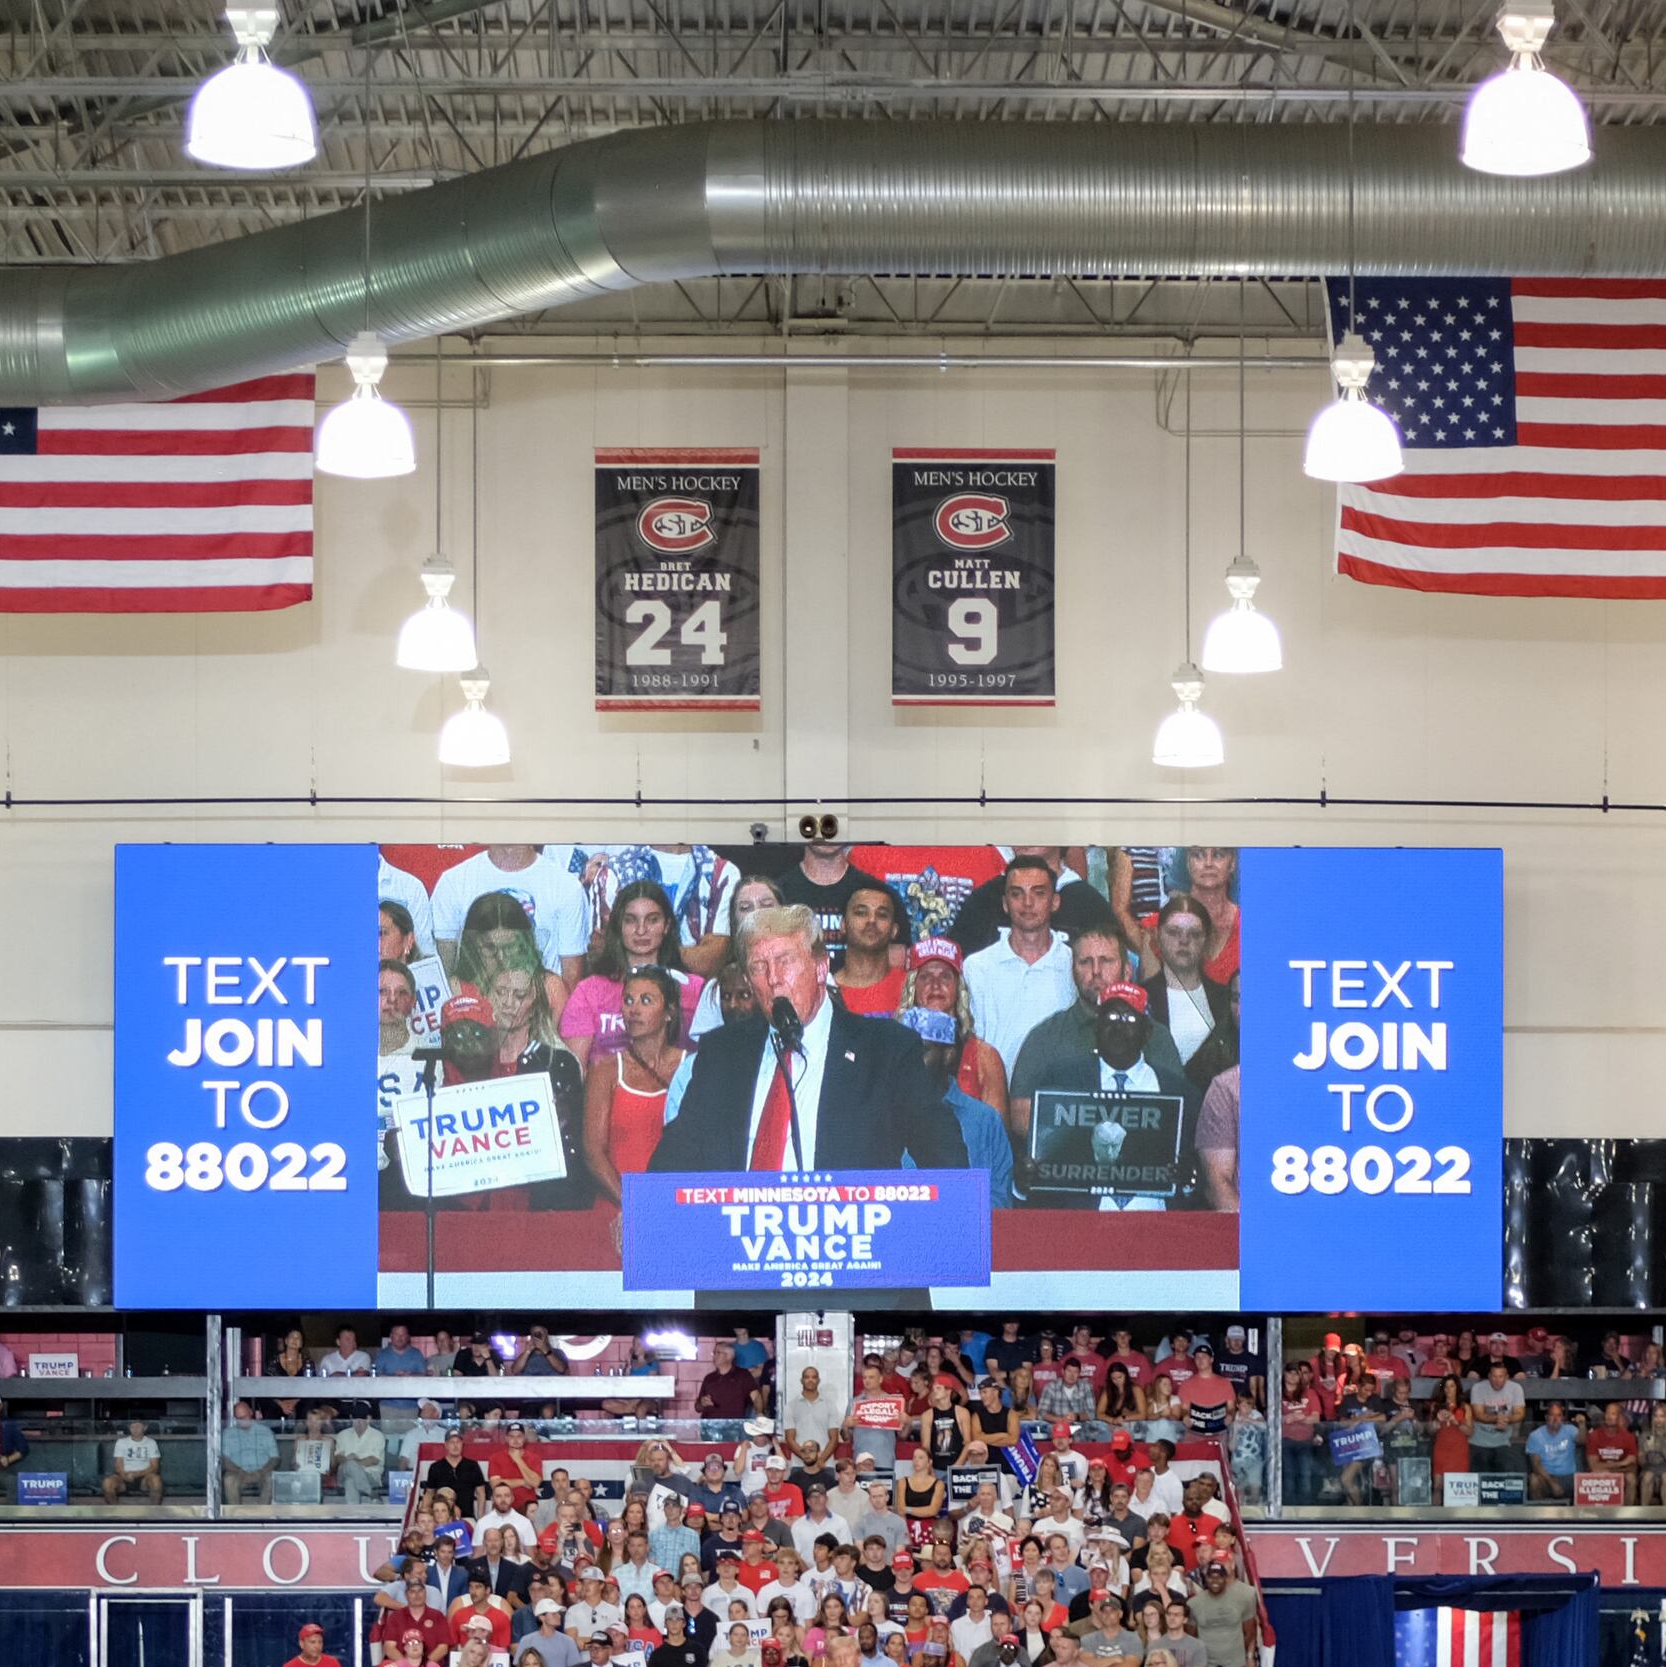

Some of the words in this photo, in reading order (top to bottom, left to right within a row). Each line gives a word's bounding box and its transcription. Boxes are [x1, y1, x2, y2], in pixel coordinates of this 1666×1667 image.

[616, 475, 668, 491] MEN'S
[672, 475, 742, 492] HOCKEY
[913, 471, 965, 486] MEN'S
[968, 471, 1039, 487] HOCKEY
[659, 562, 692, 572] BRET
[954, 559, 991, 569] MATT
[624, 573, 732, 591] HEDICAN
[928, 570, 1021, 589] CULLEN
[625, 599, 728, 666] 24
[947, 597, 998, 666] 9
[632, 674, 720, 688] 1988-1991
[928, 674, 1017, 688] 1995-1997
[163, 956, 330, 1006] TEXT
[1289, 960, 1454, 1009] TEXT
[167, 1018, 323, 1069] JOIN
[1292, 1022, 1448, 1072] JOIN
[202, 1080, 290, 1130] TO
[1327, 1083, 1415, 1134] TO
[409, 1099, 541, 1140] TRUMP
[1053, 1102, 1163, 1129] NEVER
[430, 1126, 532, 1160] VANCE
[145, 1142, 348, 1192] 88022
[1037, 1160, 1173, 1183] SURRENDER
[1271, 1145, 1473, 1196] 88022
[683, 1187, 730, 1203] TEXT
[732, 1187, 840, 1203] MINNESOTA
[843, 1187, 871, 1202] TO
[873, 1186, 931, 1202] 88022
[720, 1203, 893, 1237] TRUMP
[738, 1234, 873, 1262] VANCE
[732, 1261, 764, 1272] MAKE
[765, 1261, 809, 1272] AMERICA
[811, 1261, 847, 1272] GREAT
[848, 1261, 882, 1272] AGAIN!
[780, 1270, 833, 1288] 2024
[34, 1362, 75, 1371] TRUMP
[1219, 1362, 1248, 1373] TRUMP
[855, 1407, 899, 1416] ILLEGALS
[860, 1401, 897, 1410] DEPORT
[1332, 1430, 1373, 1448] TRUMP
[21, 1479, 64, 1489] TRUMP
[952, 1474, 978, 1483] BACK
[1481, 1480, 1506, 1489] BACK
[1580, 1479, 1617, 1487] DEPORT
[953, 1485, 972, 1494] THE
[1481, 1491, 1499, 1500] THE
[1577, 1487, 1620, 1495] ILLEGALS
[1587, 1494, 1611, 1502] NOW
[95, 1534, 402, 1586] CLOU
